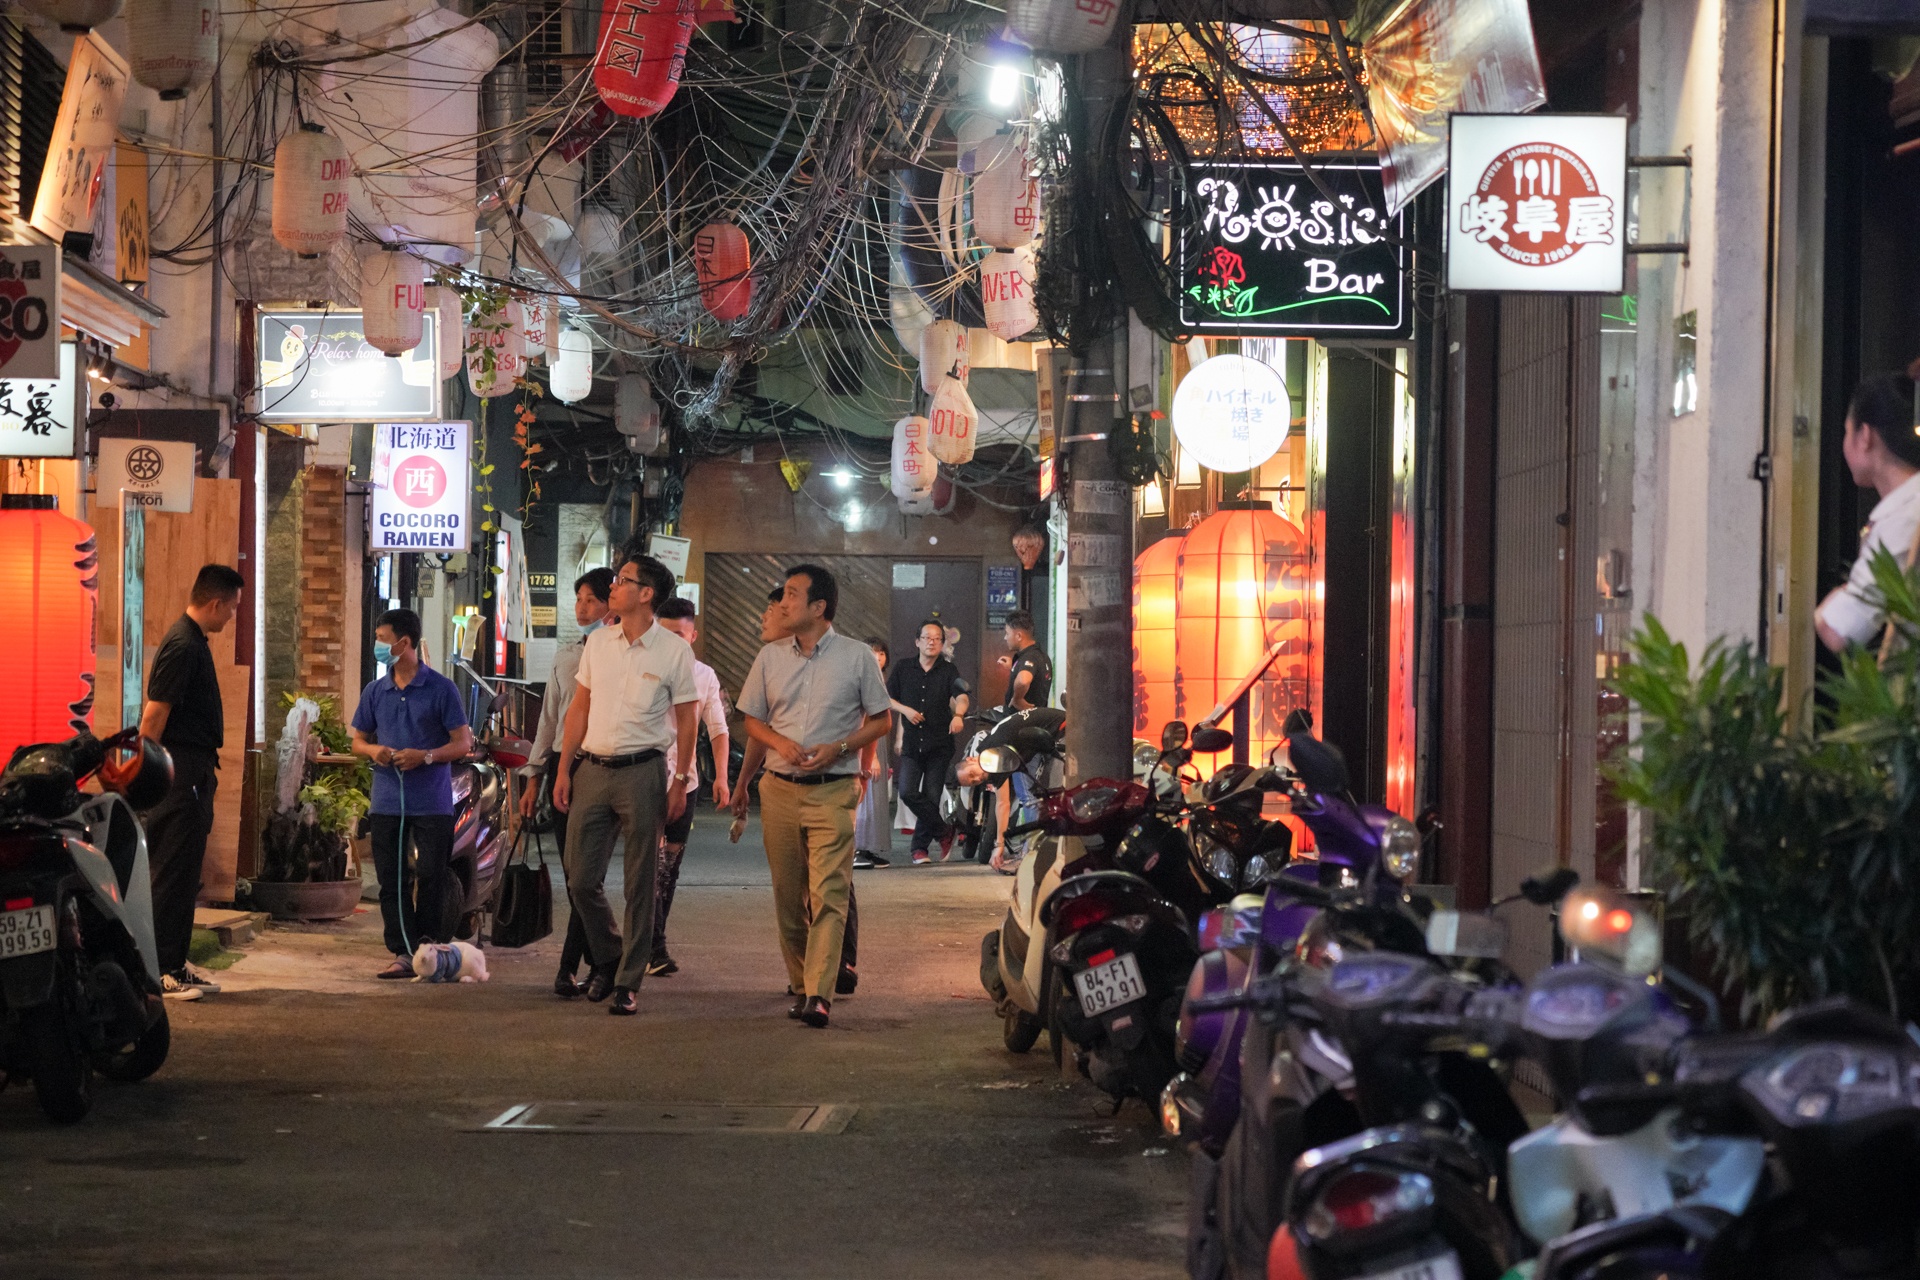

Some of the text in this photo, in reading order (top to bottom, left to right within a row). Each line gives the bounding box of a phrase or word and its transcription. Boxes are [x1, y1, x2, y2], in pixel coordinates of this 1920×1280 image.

[1460, 193, 1614, 245] 岐阜屋
[1500, 243, 1541, 265] SINCE
[1304, 258, 1384, 294] Bar
[309, 342, 386, 366] Relax hom
[391, 426, 456, 450] 北海道
[903, 424, 923, 475] 日本町
[405, 466, 436, 497] 西
[379, 513, 459, 528] COCORO
[384, 531, 455, 547] RAMEN
[530, 575, 555, 586] 17/28
[1084, 960, 1128, 991] 84-F1
